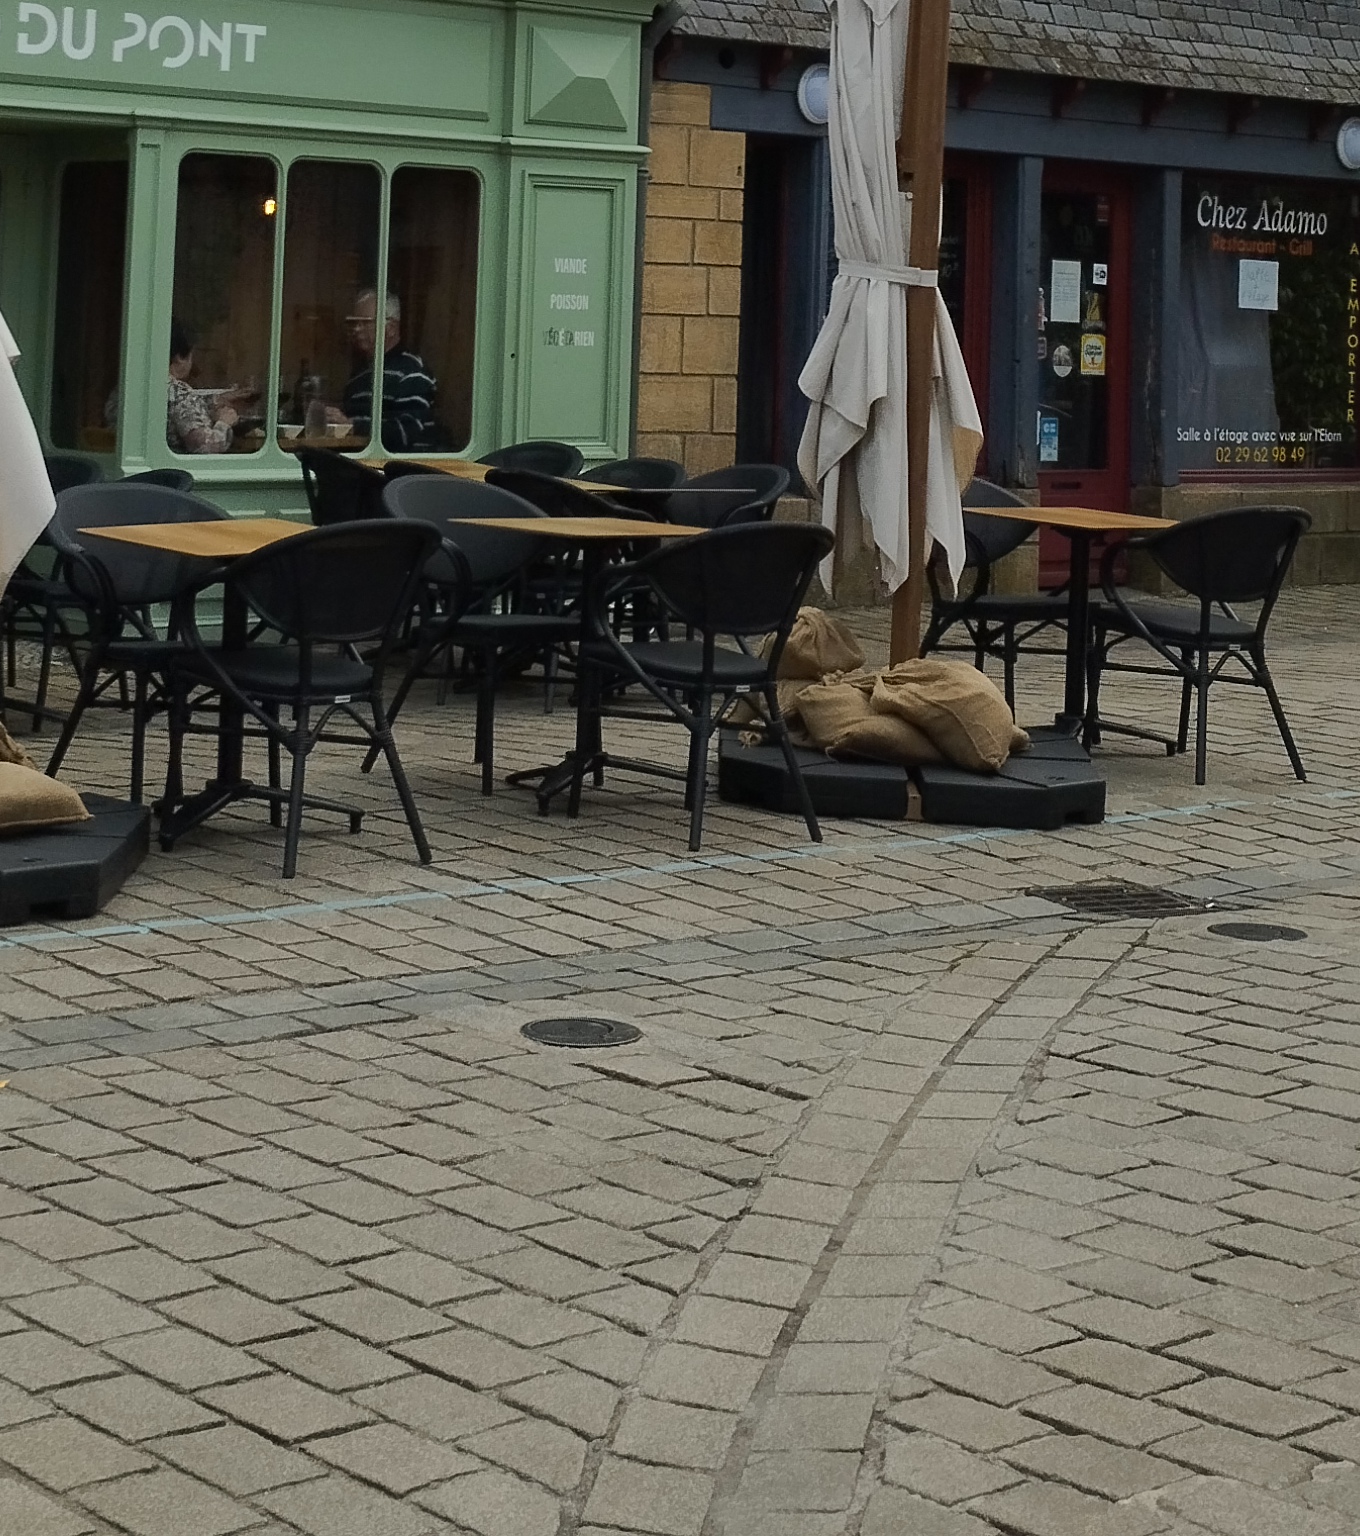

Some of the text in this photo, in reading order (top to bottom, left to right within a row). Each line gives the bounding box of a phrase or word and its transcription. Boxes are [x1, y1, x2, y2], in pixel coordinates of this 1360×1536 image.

[17, 1, 97, 60] DU
[112, 12, 267, 72] PONT
[1197, 195, 1328, 236] Chez Adamo
[1212, 233, 1277, 254] Restaurant
[1290, 238, 1314, 256] Grill
[554, 257, 588, 274] VIANDE
[550, 293, 589, 310] POISSON
[1176, 427, 1200, 442] Salle
[1203, 428, 1211, 442] à
[1251, 431, 1276, 442] avec
[1279, 431, 1296, 442] vue
[1299, 432, 1313, 442] sur
[1215, 447, 1305, 462] 02 29 62 98 49
